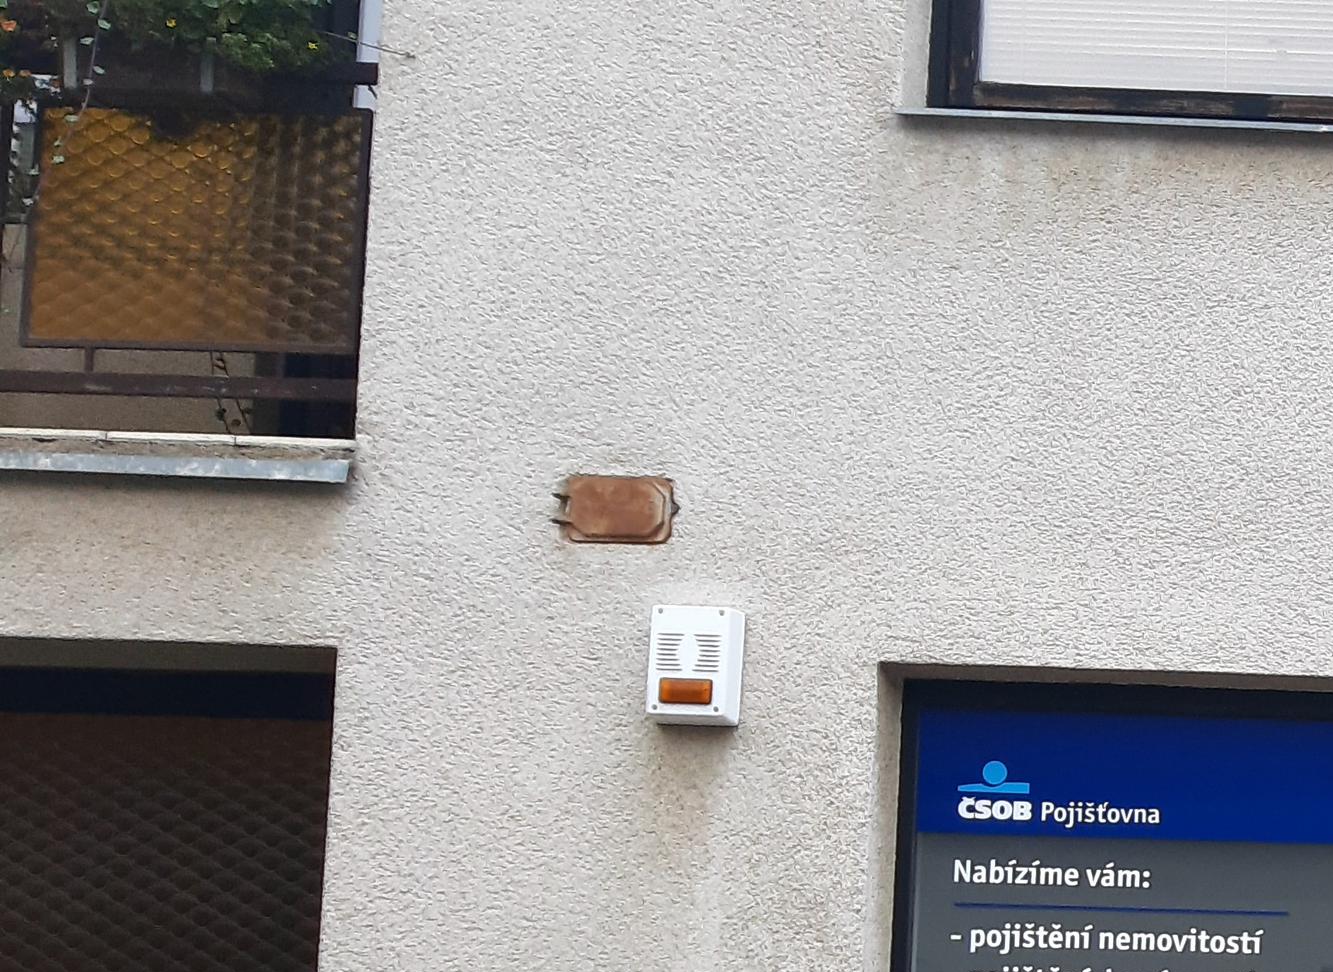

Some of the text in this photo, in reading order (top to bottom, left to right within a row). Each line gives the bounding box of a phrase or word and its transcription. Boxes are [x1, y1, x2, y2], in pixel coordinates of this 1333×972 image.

[957, 796, 1160, 826] ČSOB Pojišťovna
[953, 859, 1152, 889] Nabízíme vám:
[969, 922, 1094, 955] pojištění
[1098, 927, 1264, 954] nemovitostí
